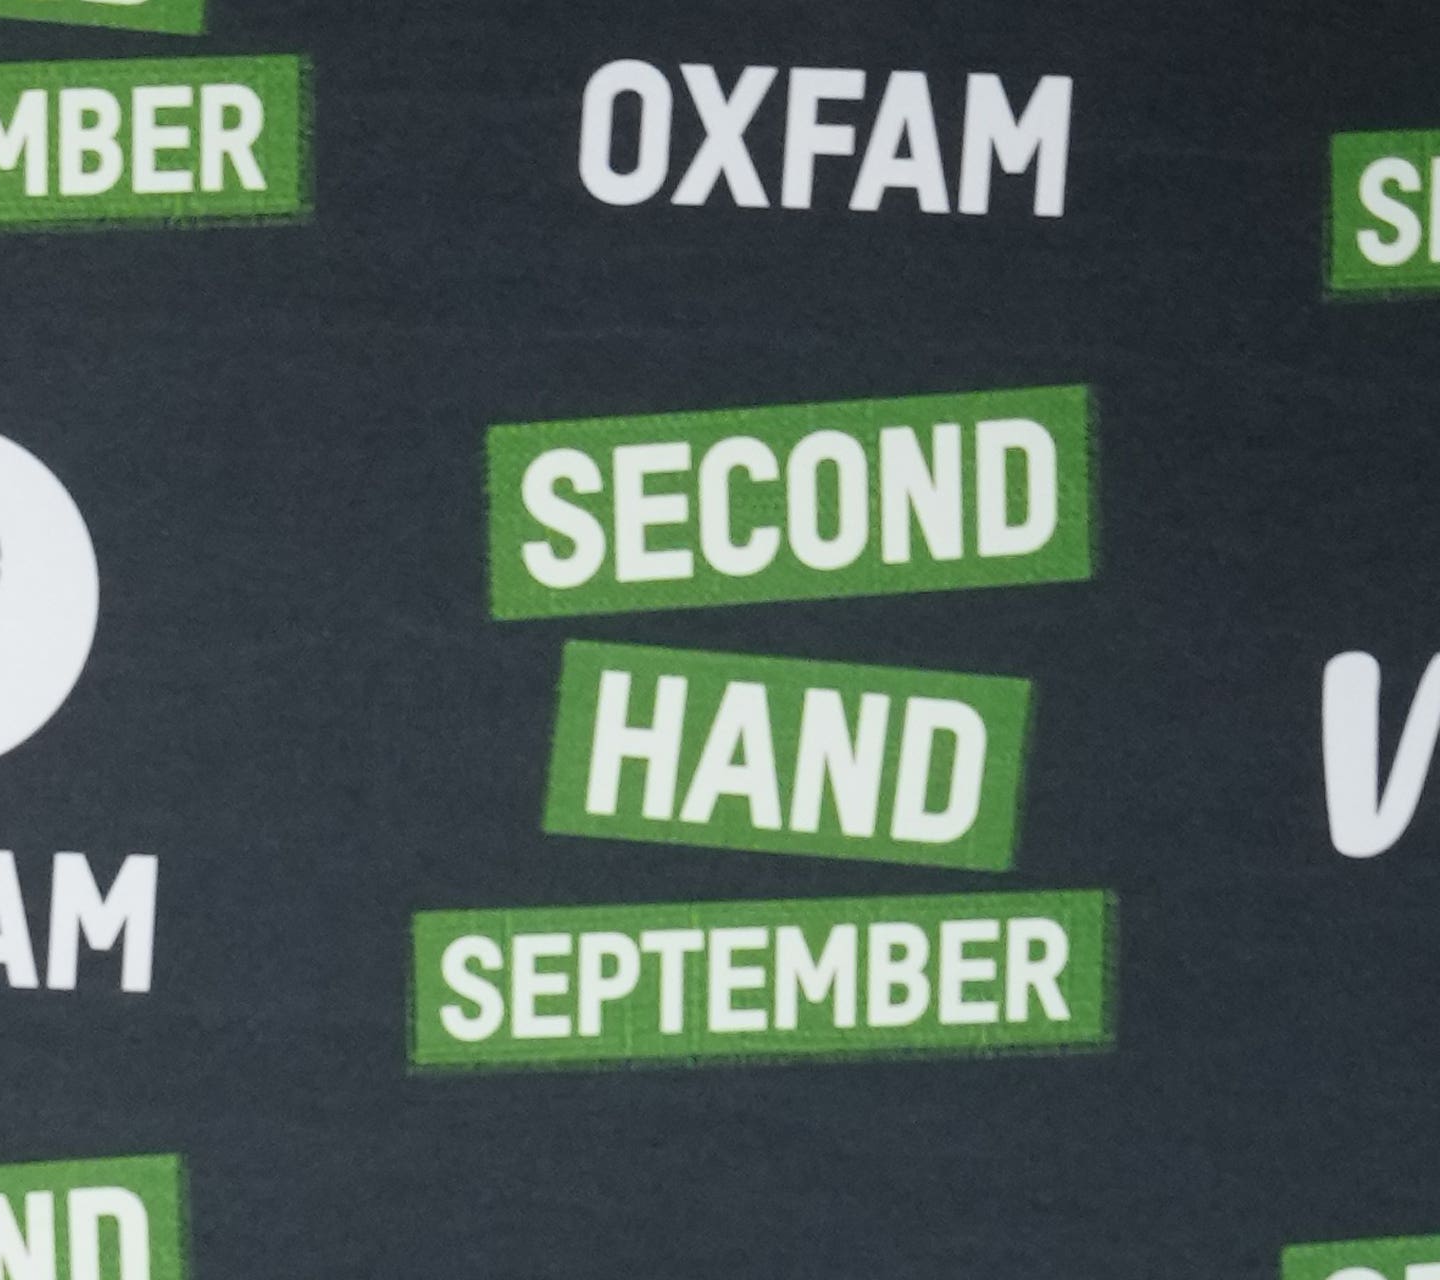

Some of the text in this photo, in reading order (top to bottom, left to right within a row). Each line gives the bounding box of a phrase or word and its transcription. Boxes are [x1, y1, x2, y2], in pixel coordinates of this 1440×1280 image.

[579, 60, 1072, 216] OXFAM
[522, 418, 1057, 587] SECOND
[586, 670, 987, 842] HAND
[440, 917, 1069, 1041] SEPTEMBER
